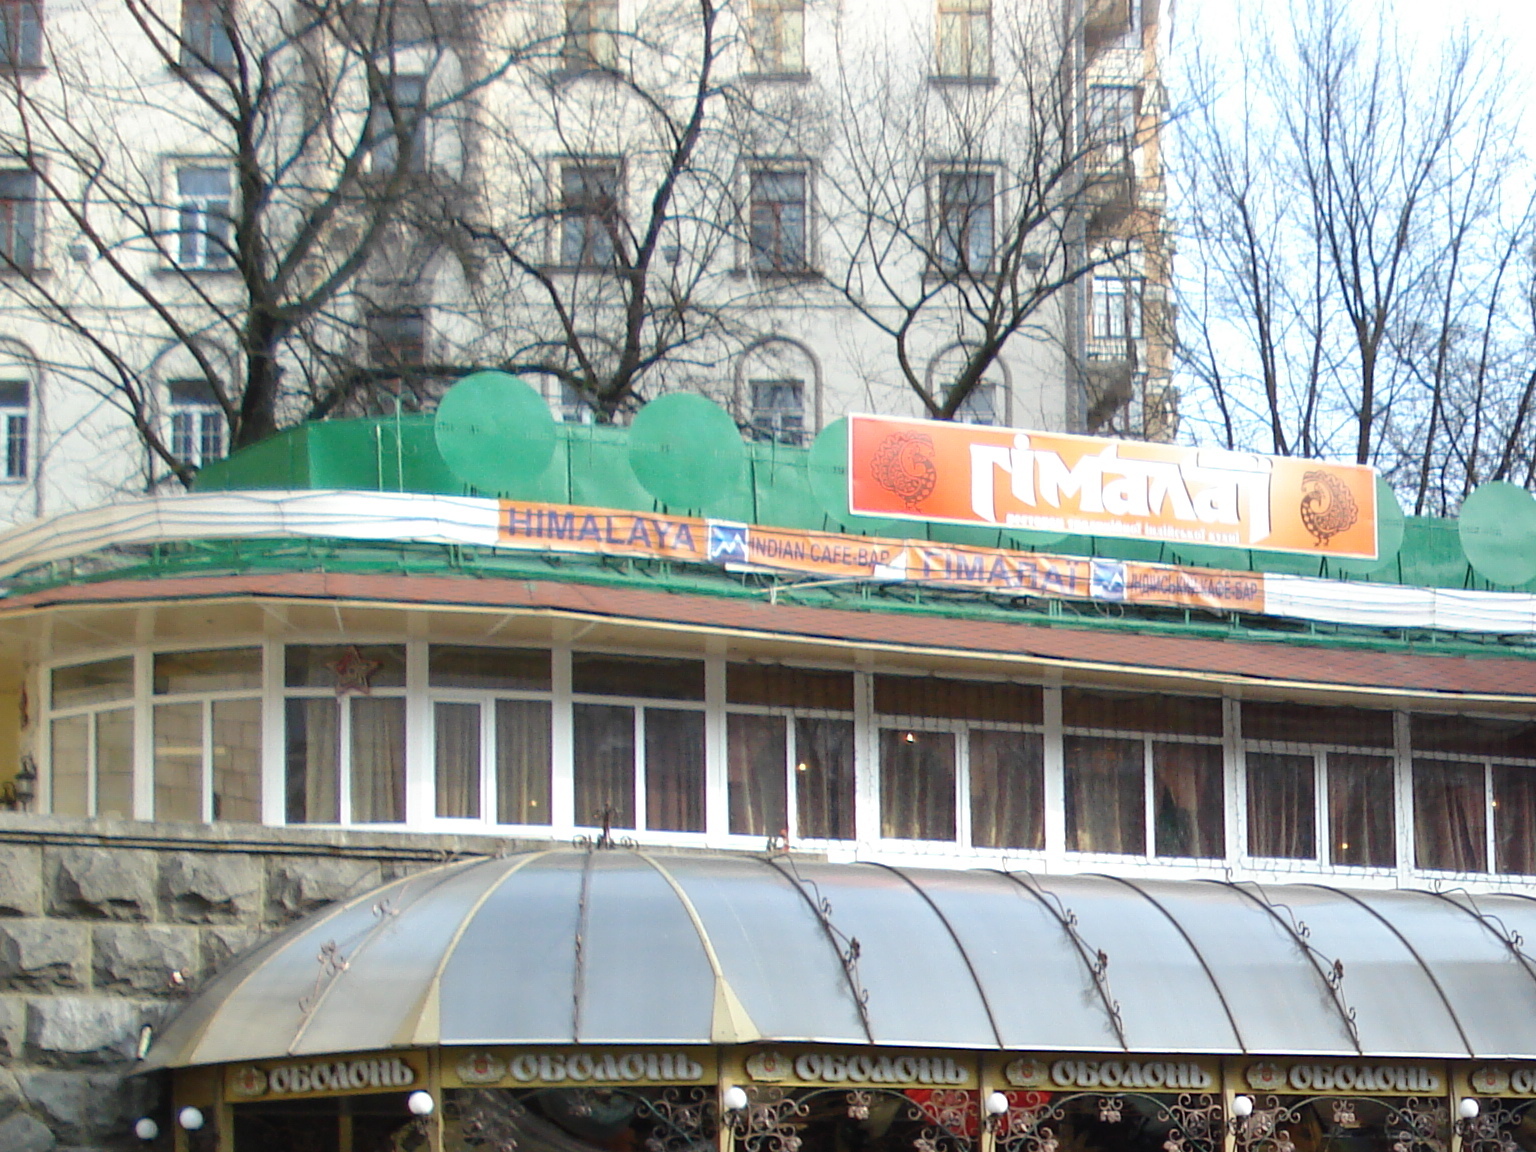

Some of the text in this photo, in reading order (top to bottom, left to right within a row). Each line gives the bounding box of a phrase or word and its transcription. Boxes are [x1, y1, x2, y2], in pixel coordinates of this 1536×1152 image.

[508, 506, 696, 553] HIMALAYA
[750, 536, 806, 562] INDIAN
[923, 550, 1079, 597] ГІМАЛАЇ
[268, 1057, 416, 1093] ОБОЛОНЬ
[509, 1052, 704, 1083] ОБОЛОНЬ
[796, 1053, 969, 1085] ОБОЛОНЬ
[1051, 1058, 1212, 1089] ОБОЛОНЬ
[1288, 1063, 1440, 1092] ОБОЛОНЬ
